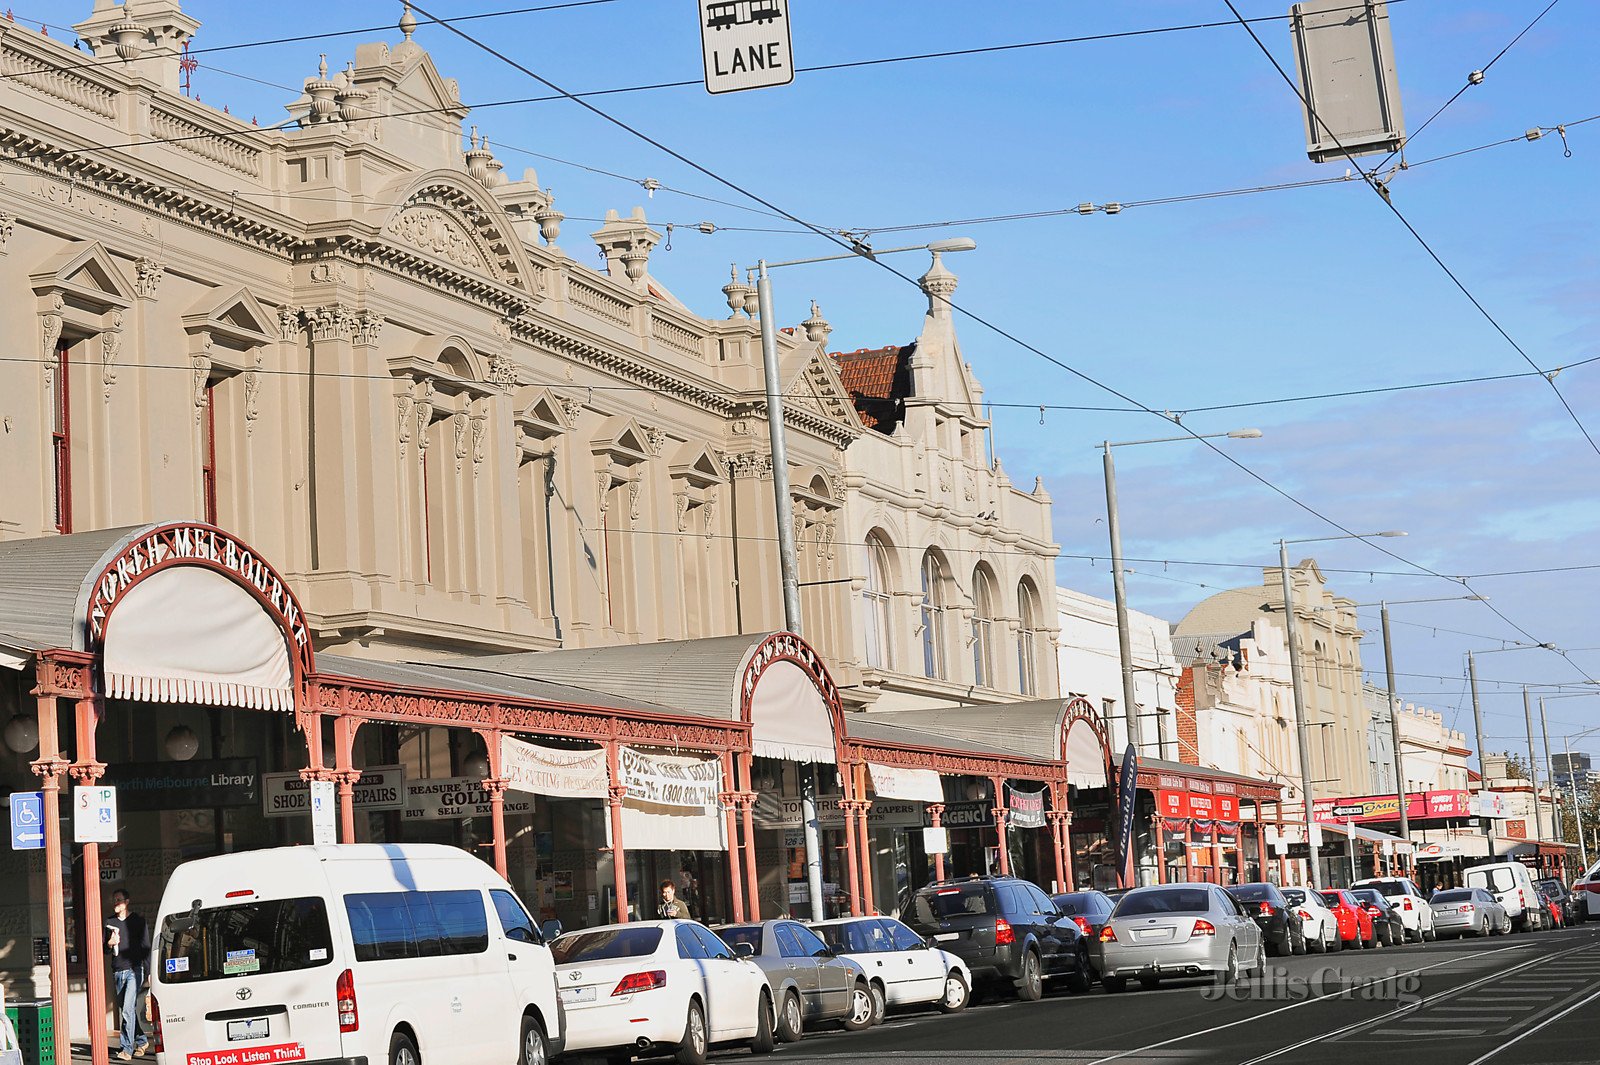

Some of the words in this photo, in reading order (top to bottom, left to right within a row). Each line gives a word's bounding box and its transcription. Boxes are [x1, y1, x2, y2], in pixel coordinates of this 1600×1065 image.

[713, 41, 782, 76] LANE
[89, 534, 162, 638] NORTH
[174, 527, 309, 647] MELBOURNE
[687, 762, 715, 781] GOLD
[145, 776, 209, 789] Melbourne
[211, 773, 254, 787] Library
[99, 789, 111, 803] 1P
[407, 783, 461, 795] REASURE
[662, 783, 683, 803] 1300
[274, 793, 305, 809] SHOE
[353, 787, 397, 803] EPAIRS
[441, 791, 490, 806] GOLD
[406, 809, 426, 818] BUY
[437, 807, 463, 816] SELL
[475, 802, 530, 814] EXCANGE
[876, 805, 914, 814] CAPERS
[1438, 803, 1454, 812] DAYS
[99, 858, 121, 868] KEYS
[100, 870, 117, 880] CUT
[292, 1001, 330, 1010] COMMUTER
[166, 1016, 186, 1024] HIACE
[190, 1056, 212, 1065] Stop
[214, 1053, 238, 1065] Look
[242, 1051, 271, 1063] Listen
[273, 1046, 302, 1059] Think
